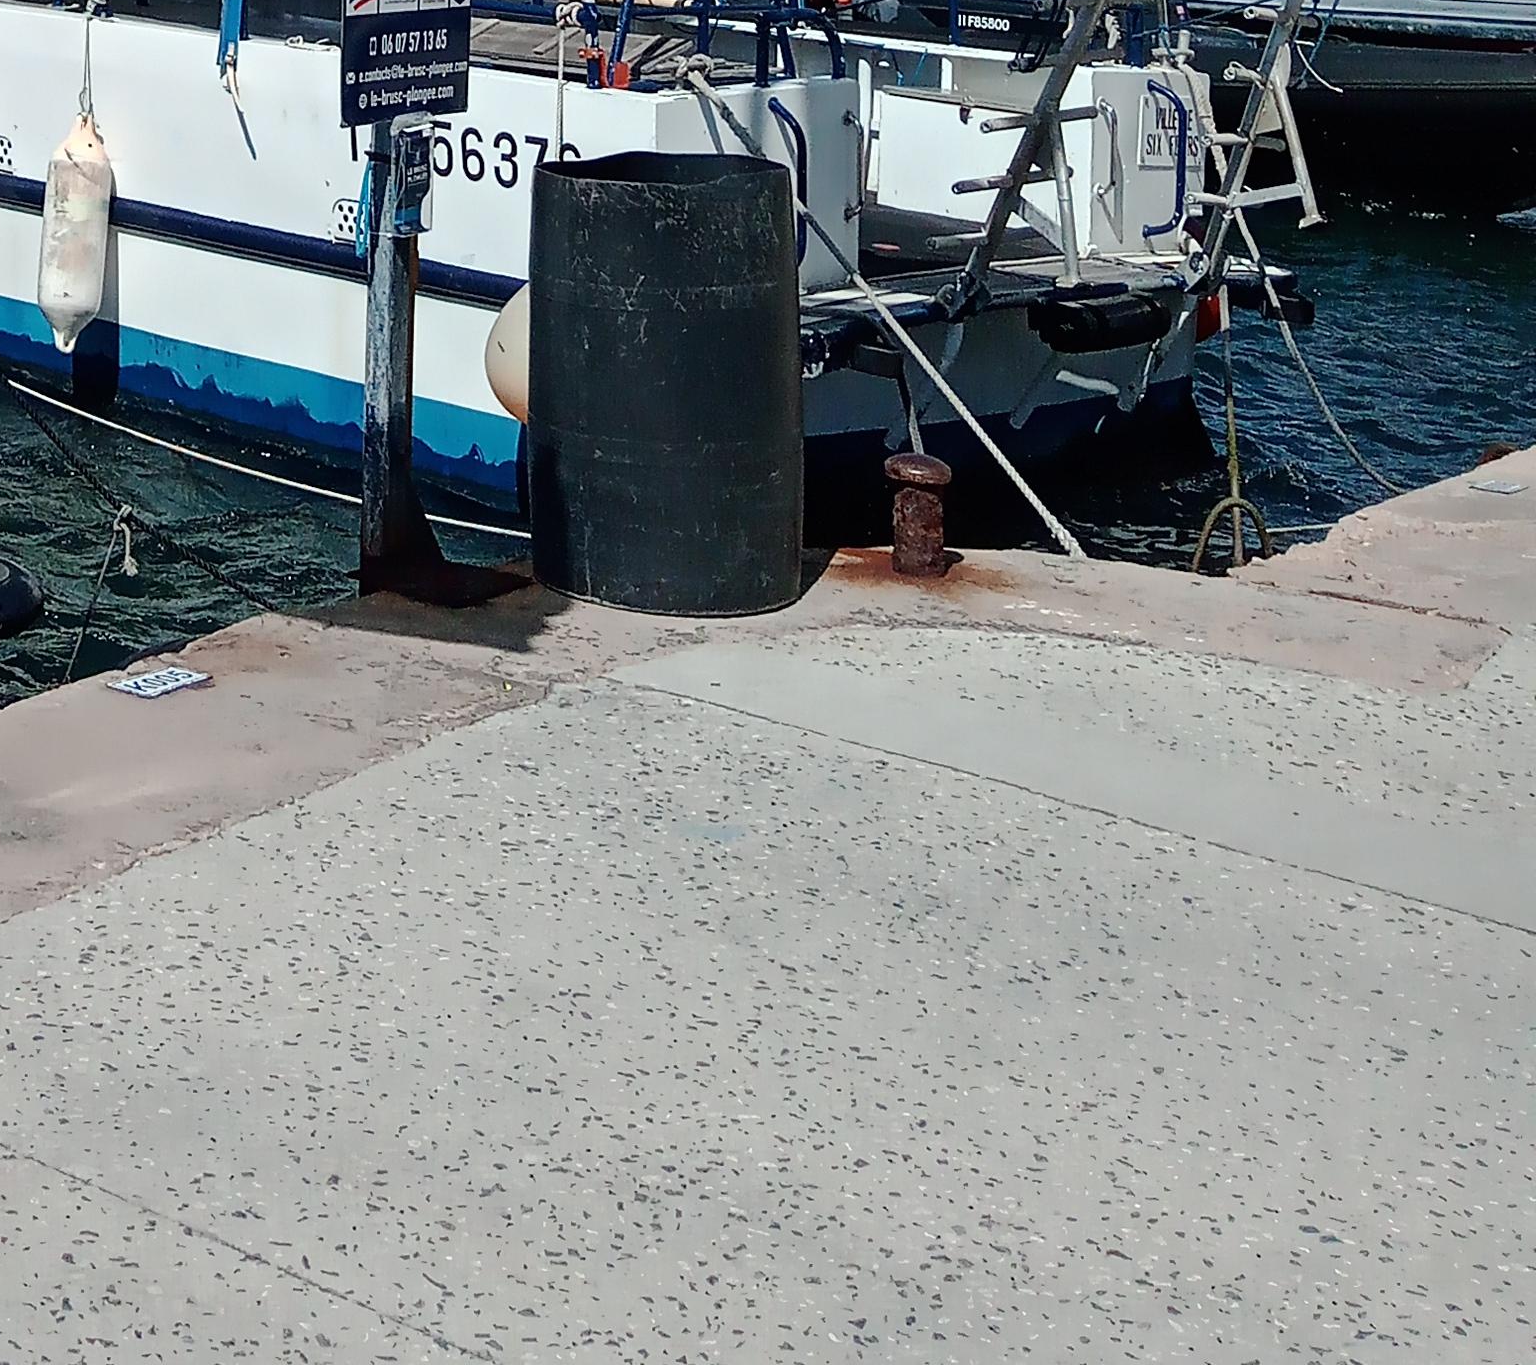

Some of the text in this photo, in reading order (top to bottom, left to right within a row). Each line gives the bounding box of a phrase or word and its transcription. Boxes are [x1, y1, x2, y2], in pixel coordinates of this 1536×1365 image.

[381, 29, 448, 55] 06 07 57 13 65
[1146, 133, 1162, 156] SIX
